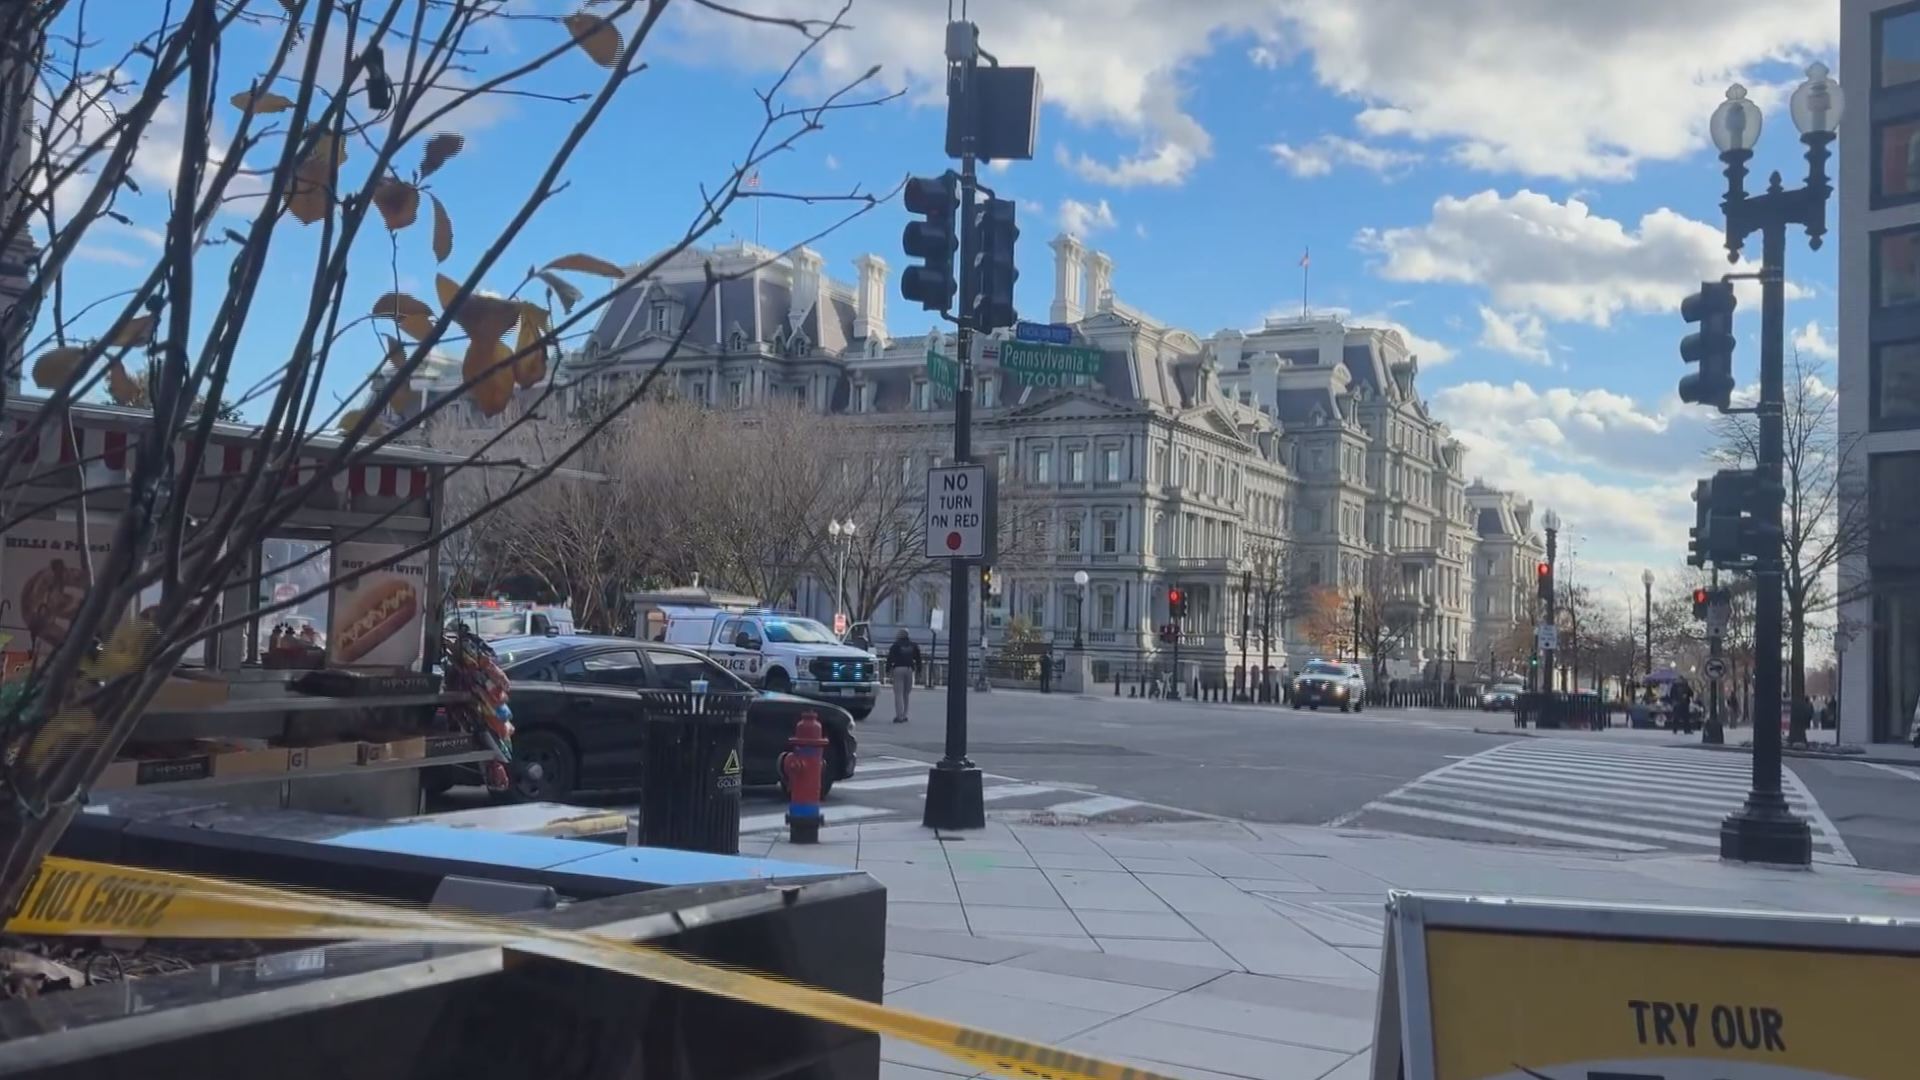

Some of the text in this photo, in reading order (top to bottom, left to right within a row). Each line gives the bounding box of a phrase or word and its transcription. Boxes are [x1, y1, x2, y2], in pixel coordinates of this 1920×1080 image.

[1004, 343, 1084, 373] Pennsylvania
[1018, 371, 1058, 387] 1700
[944, 473, 968, 491] NO
[940, 495, 973, 510] TURN
[931, 513, 979, 529] ON RED
[713, 658, 746, 671] OLICE
[1627, 999, 1787, 1052] TRY OUR
